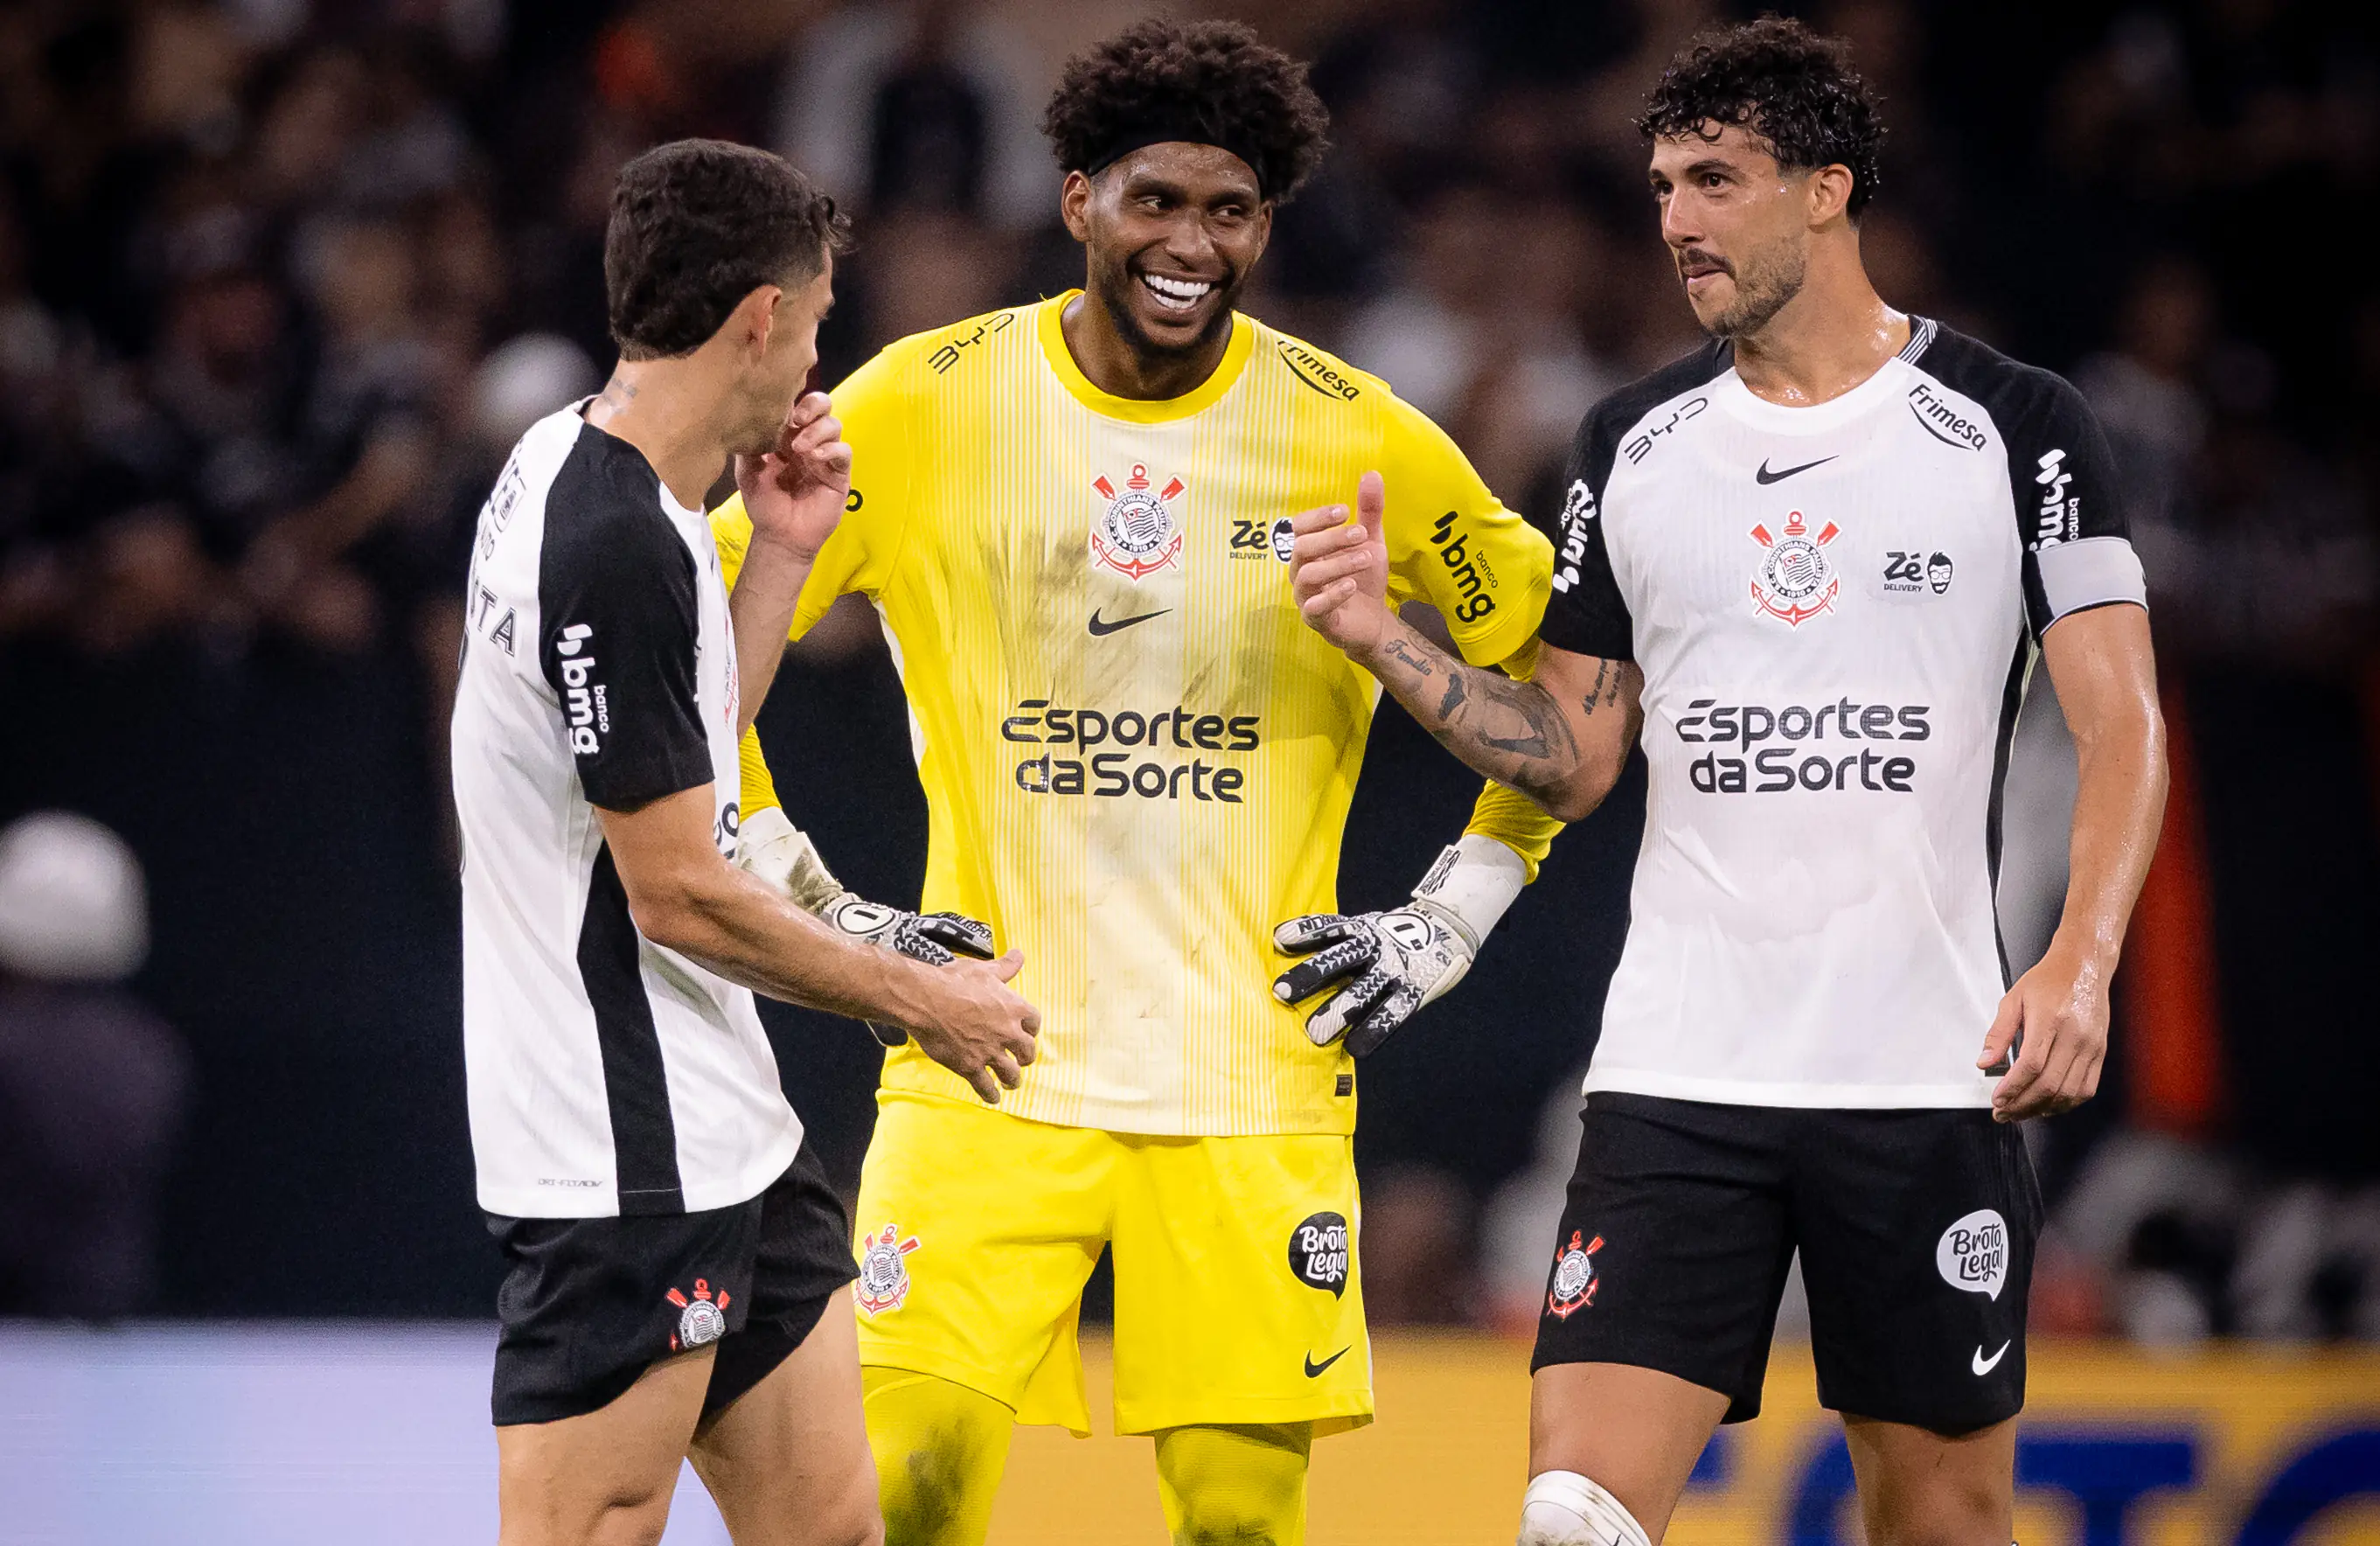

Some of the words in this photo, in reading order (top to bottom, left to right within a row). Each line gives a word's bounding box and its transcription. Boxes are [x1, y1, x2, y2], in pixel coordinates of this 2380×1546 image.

[1909, 383, 1987, 452] Frimesa
[1230, 520, 1270, 550] Zé
[2069, 498, 2080, 540] banco
[1440, 533, 1495, 623] bmg
[1476, 550, 1498, 588] banco
[1883, 551, 1924, 581] Zé
[1883, 583, 1924, 592] DELIVERY
[561, 658, 600, 754] bmg
[594, 685, 609, 733] banco
[1675, 696, 1931, 755] Esportes
[1001, 699, 1260, 756] Esportes
[1299, 1225, 1347, 1253] Broto
[1949, 1223, 2001, 1256] Broto
[1959, 1243, 2003, 1283] Legal
